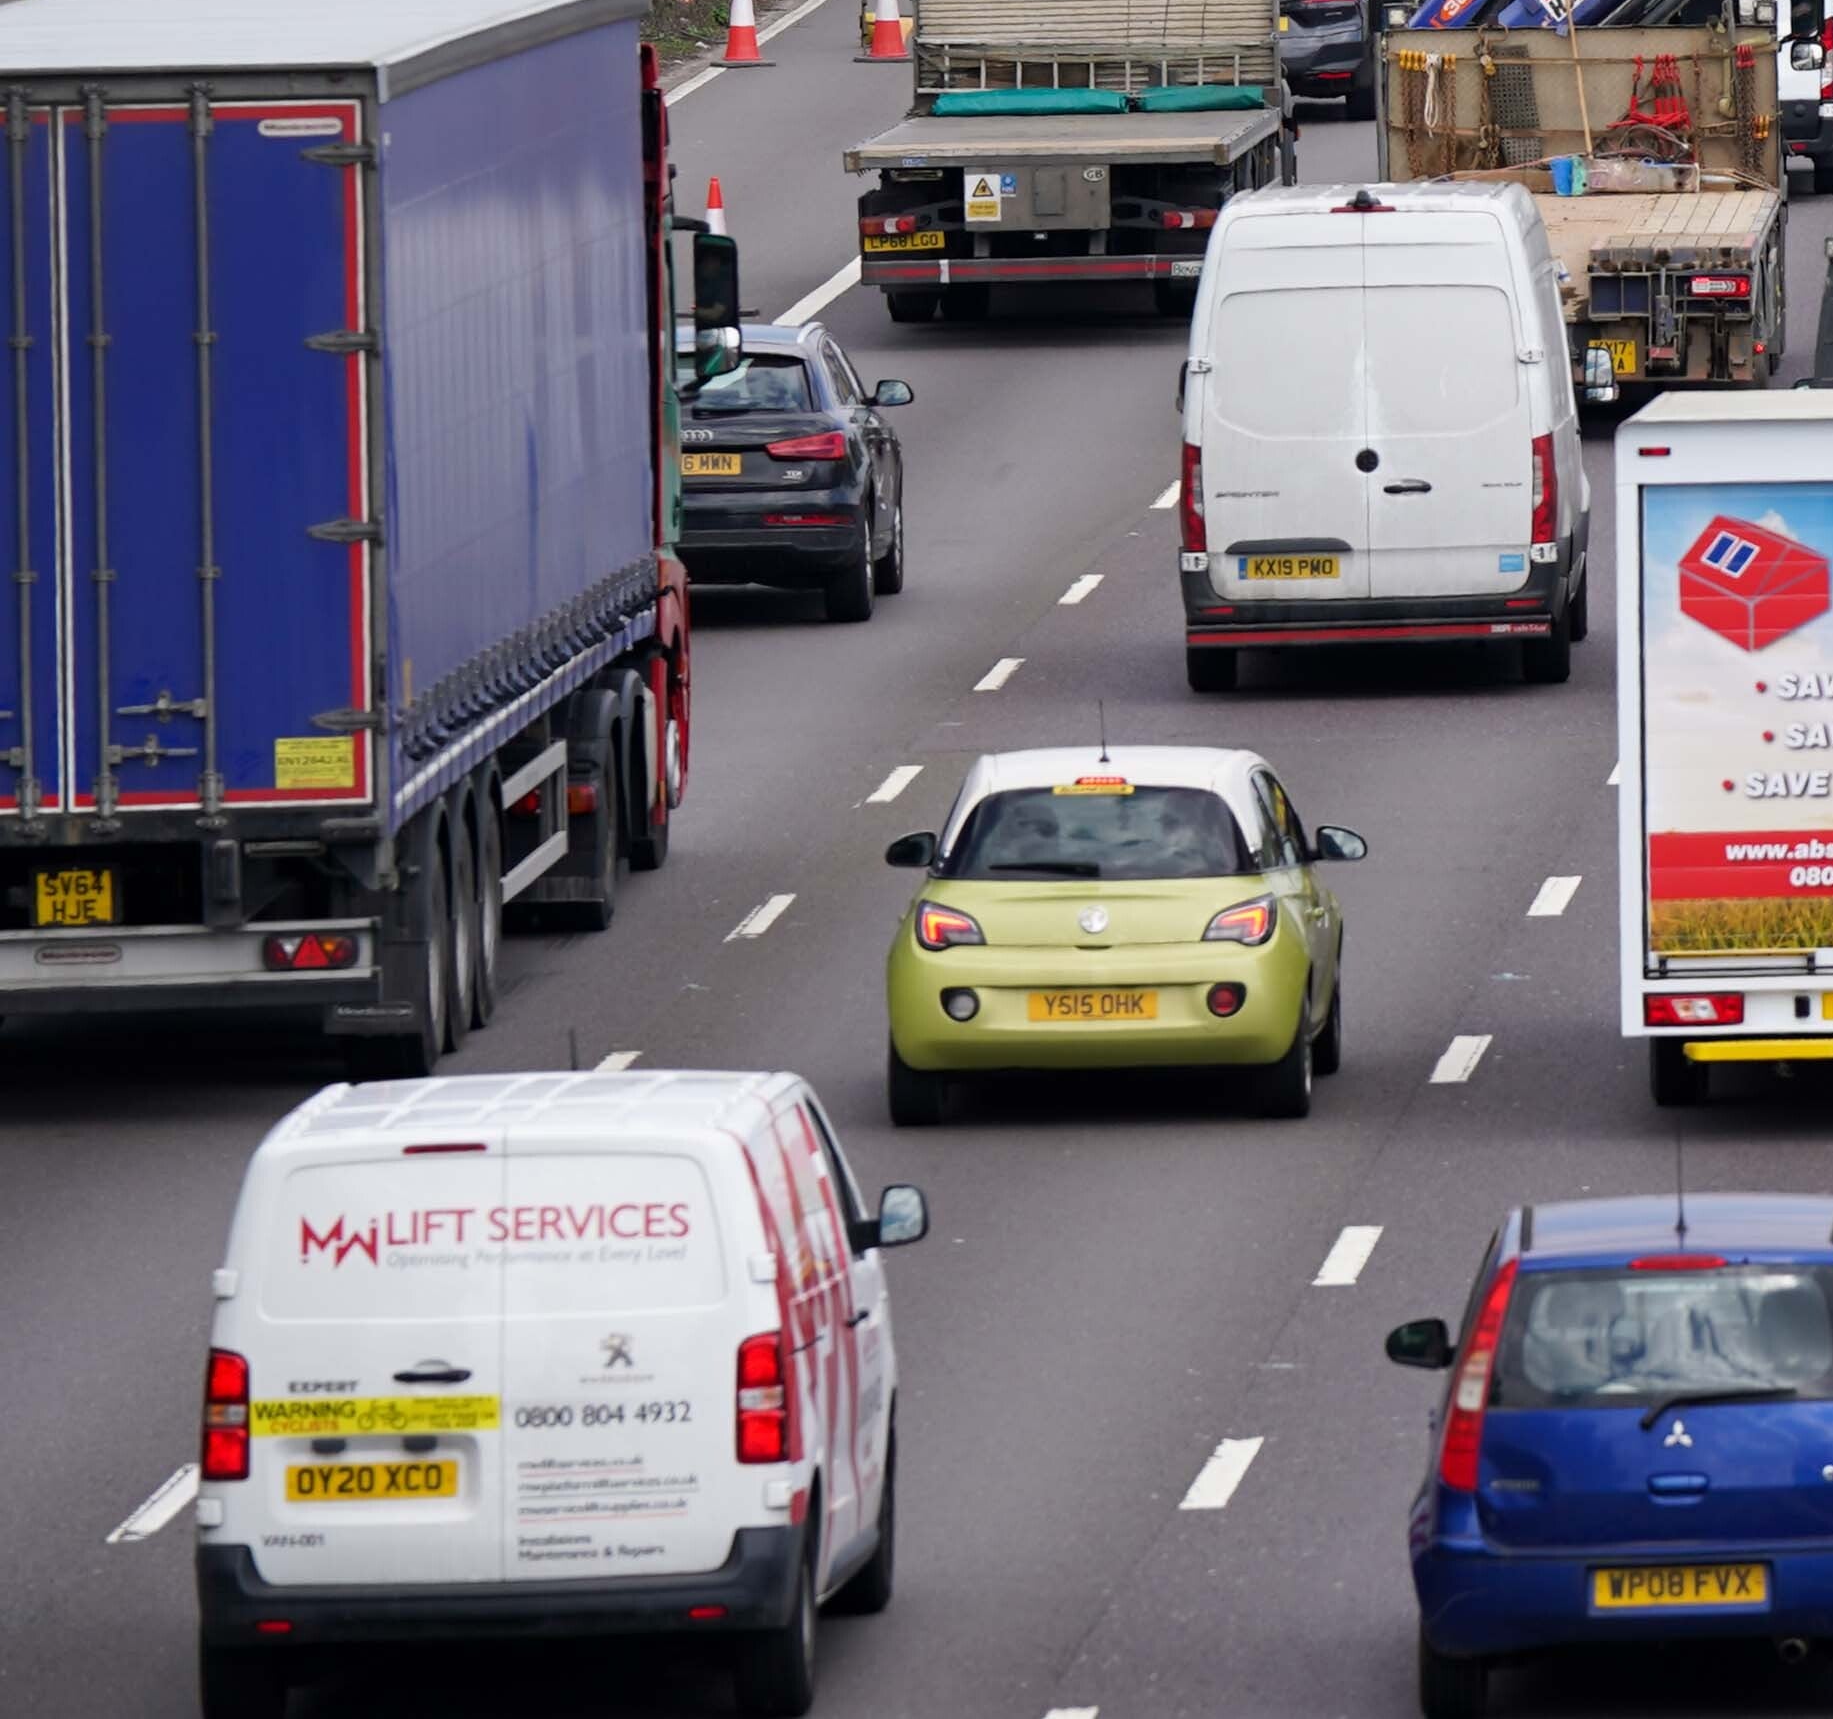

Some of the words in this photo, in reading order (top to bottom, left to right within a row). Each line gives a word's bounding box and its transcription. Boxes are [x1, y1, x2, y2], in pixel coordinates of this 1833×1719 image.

[1086, 170, 1104, 179] GB
[700, 455, 733, 470] MWN
[1255, 559, 1293, 576] KX19
[1298, 558, 1333, 575] PMO
[1746, 770, 1829, 799] SAVE
[45, 875, 102, 897] SV64
[52, 899, 97, 922] HJE
[1044, 993, 1094, 1016] YS15
[1101, 993, 1145, 1016] OHK
[387, 1209, 475, 1247] LIFT
[488, 1203, 690, 1243] SERVICES
[600, 1245, 641, 1265] Every
[648, 1244, 688, 1260] Level
[288, 1380, 358, 1394] EXPERT
[254, 1401, 357, 1420] WARNING
[515, 1406, 573, 1429] 0800
[582, 1404, 624, 1426] 804
[634, 1401, 692, 1424] 4932
[270, 1419, 340, 1434] CYCLISTS
[297, 1466, 375, 1495] OY20
[384, 1464, 442, 1493] XCO
[618, 1545, 666, 1558] Repairs
[1610, 1571, 1684, 1600] WP08
[1694, 1568, 1751, 1598] FVX
